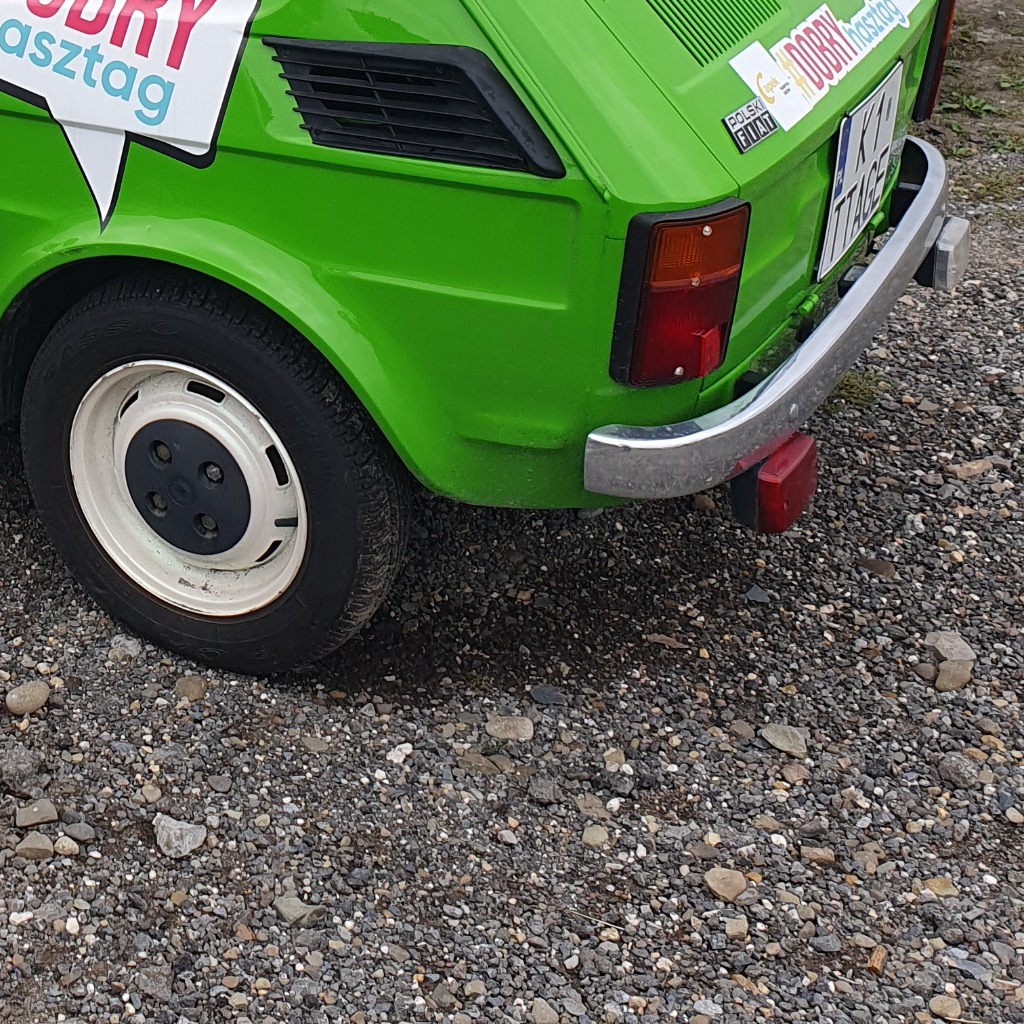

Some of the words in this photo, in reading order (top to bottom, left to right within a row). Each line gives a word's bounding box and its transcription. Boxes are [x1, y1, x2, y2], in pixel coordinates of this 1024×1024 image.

[728, 98, 765, 130] POLSKI
[736, 113, 774, 147] FIAT
[855, 90, 885, 173] K1
[830, 144, 890, 262] TTAGE
